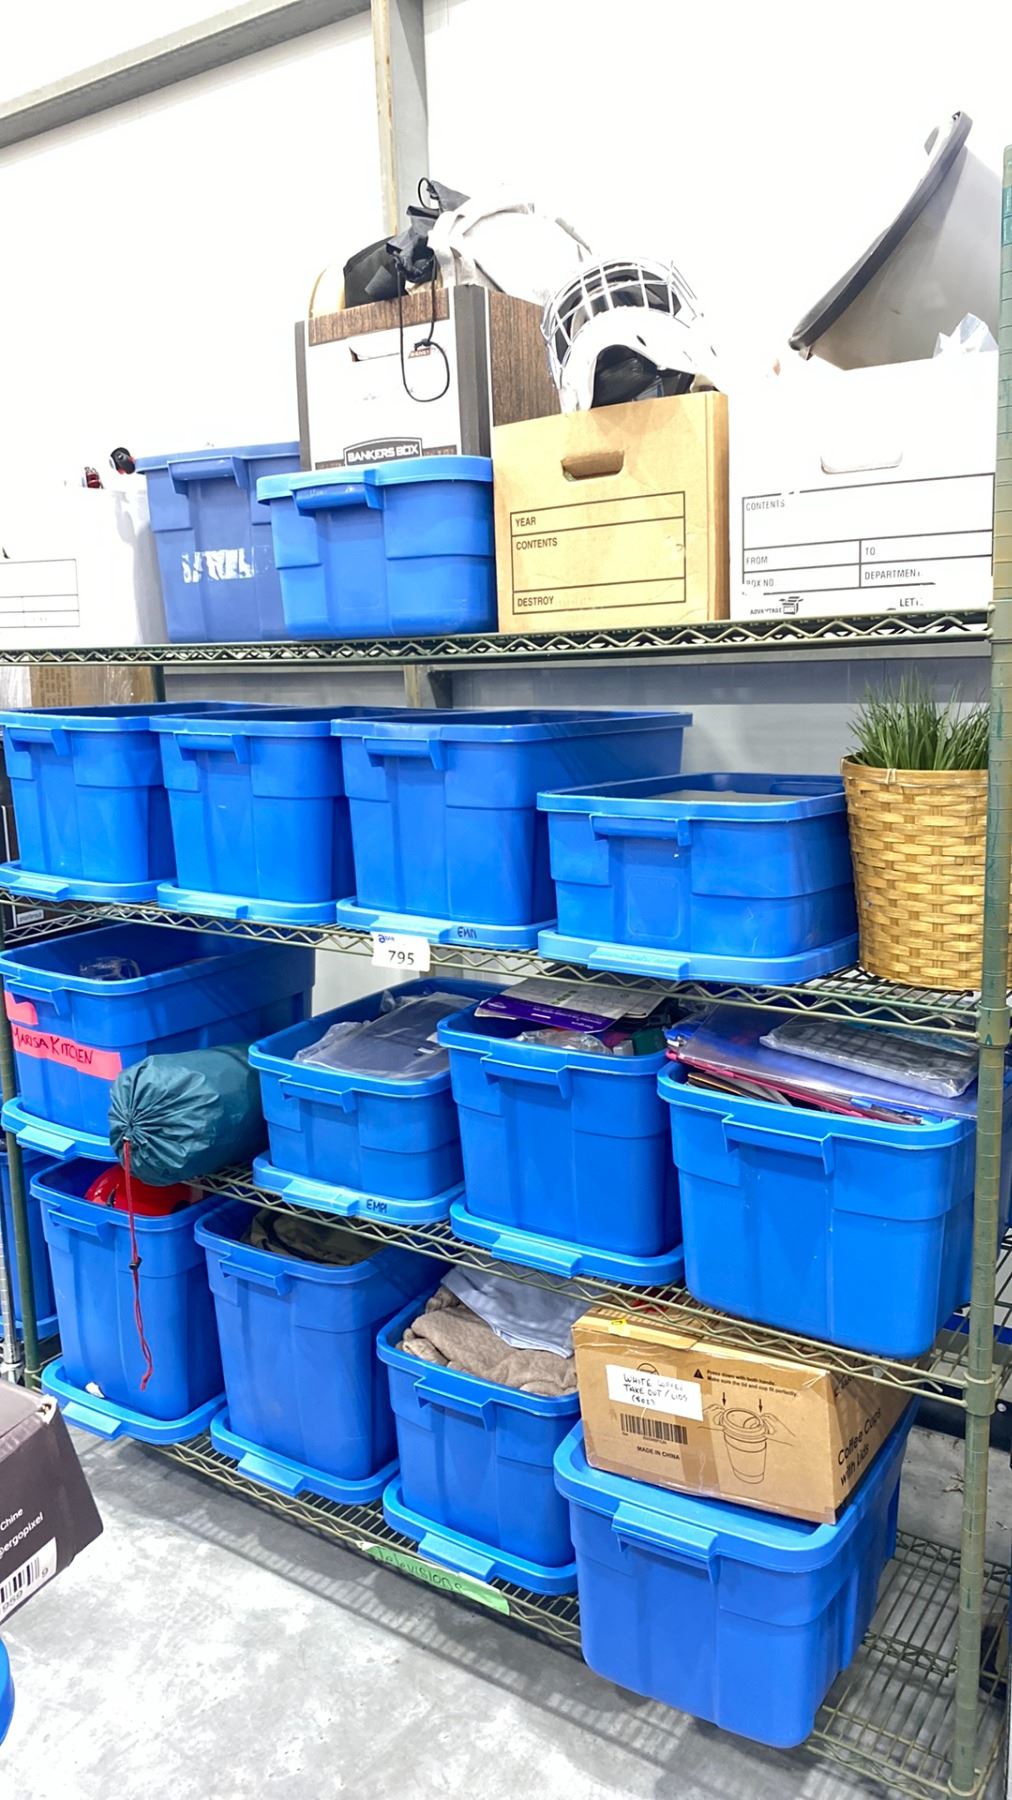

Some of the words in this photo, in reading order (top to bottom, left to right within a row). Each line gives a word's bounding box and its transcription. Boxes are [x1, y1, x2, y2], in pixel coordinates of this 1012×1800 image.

[347, 447, 395, 463] BANKERS
[396, 444, 419, 456] BOX
[745, 499, 785, 512] CONTENTS
[515, 516, 537, 528] YEAR
[516, 537, 558, 551] CONTENTS
[865, 546, 876, 556] TO
[746, 555, 768, 565] FROM
[517, 596, 554, 608] DESTROY
[388, 949, 415, 966] 795
[623, 1373, 652, 1387] WHITE
[623, 1383, 645, 1395] TAKE
[647, 1388, 662, 1398] OUT
[838, 1432, 863, 1465] Coffee
[864, 1407, 881, 1434] Cups
[637, 1446, 654, 1455] MADE
[661, 1451, 680, 1461] CHINA
[841, 1461, 856, 1486] with
[857, 1443, 869, 1467] Lids
[0, 1508, 23, 1531] Chine
